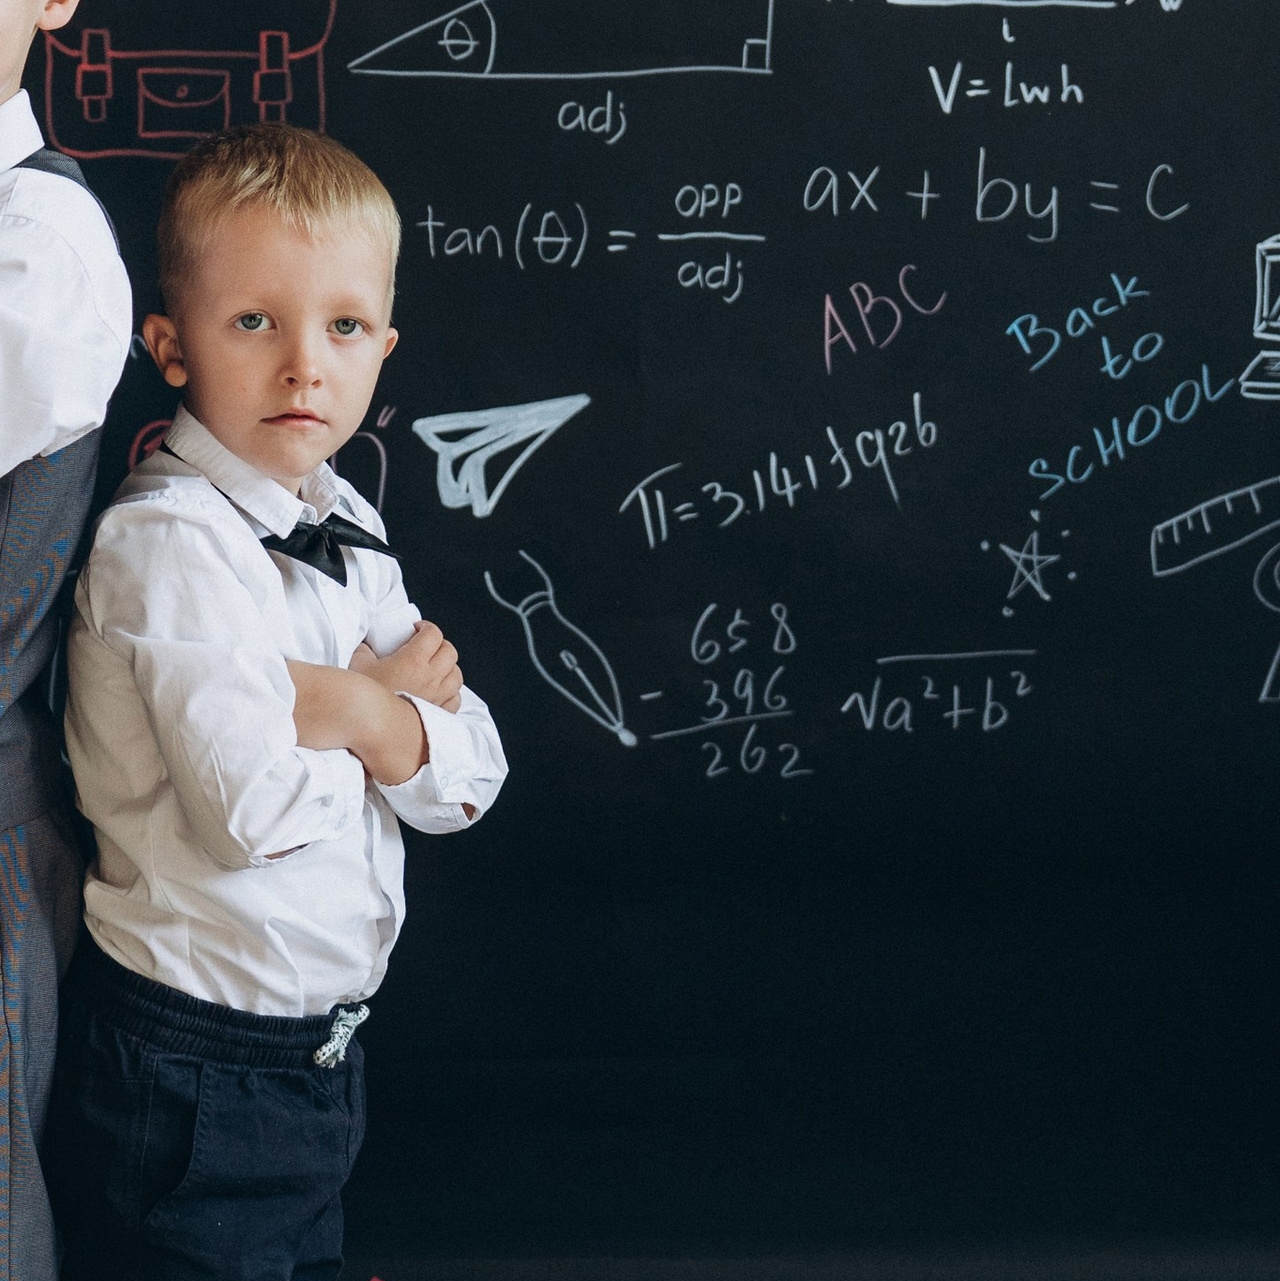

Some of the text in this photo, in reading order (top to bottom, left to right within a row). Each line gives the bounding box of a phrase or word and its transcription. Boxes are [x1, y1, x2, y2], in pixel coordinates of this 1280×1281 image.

[556, 89, 628, 146] adj
[676, 251, 744, 305] adj
[823, 264, 947, 375] ABC
[1005, 271, 1150, 372] Back
[1099, 332, 1165, 380] to
[1027, 363, 1235, 500] SCHOOL
